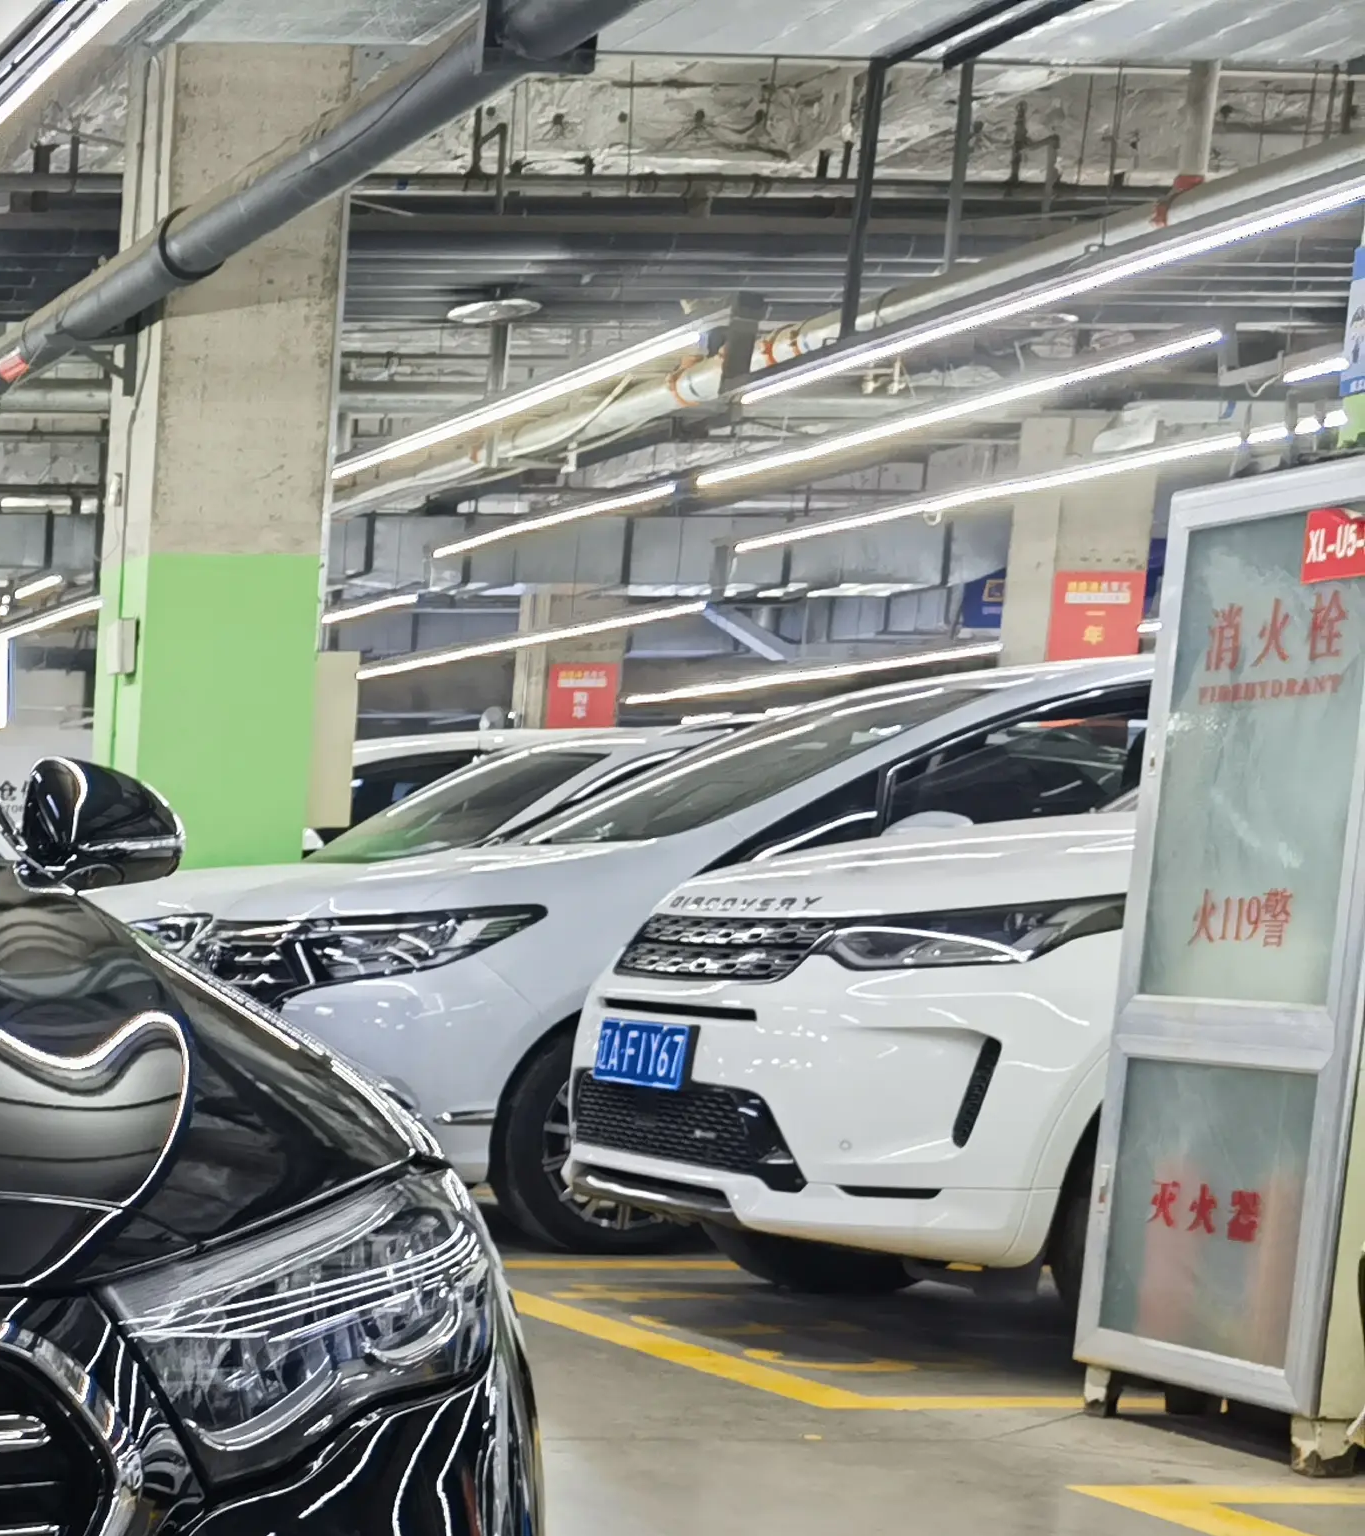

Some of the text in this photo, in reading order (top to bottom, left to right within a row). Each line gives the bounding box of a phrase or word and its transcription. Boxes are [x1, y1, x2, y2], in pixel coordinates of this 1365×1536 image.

[1305, 522, 1365, 564] XL-U5-
[1204, 589, 1349, 672] 消火栓
[1147, 1179, 1263, 1243] 灭火器
